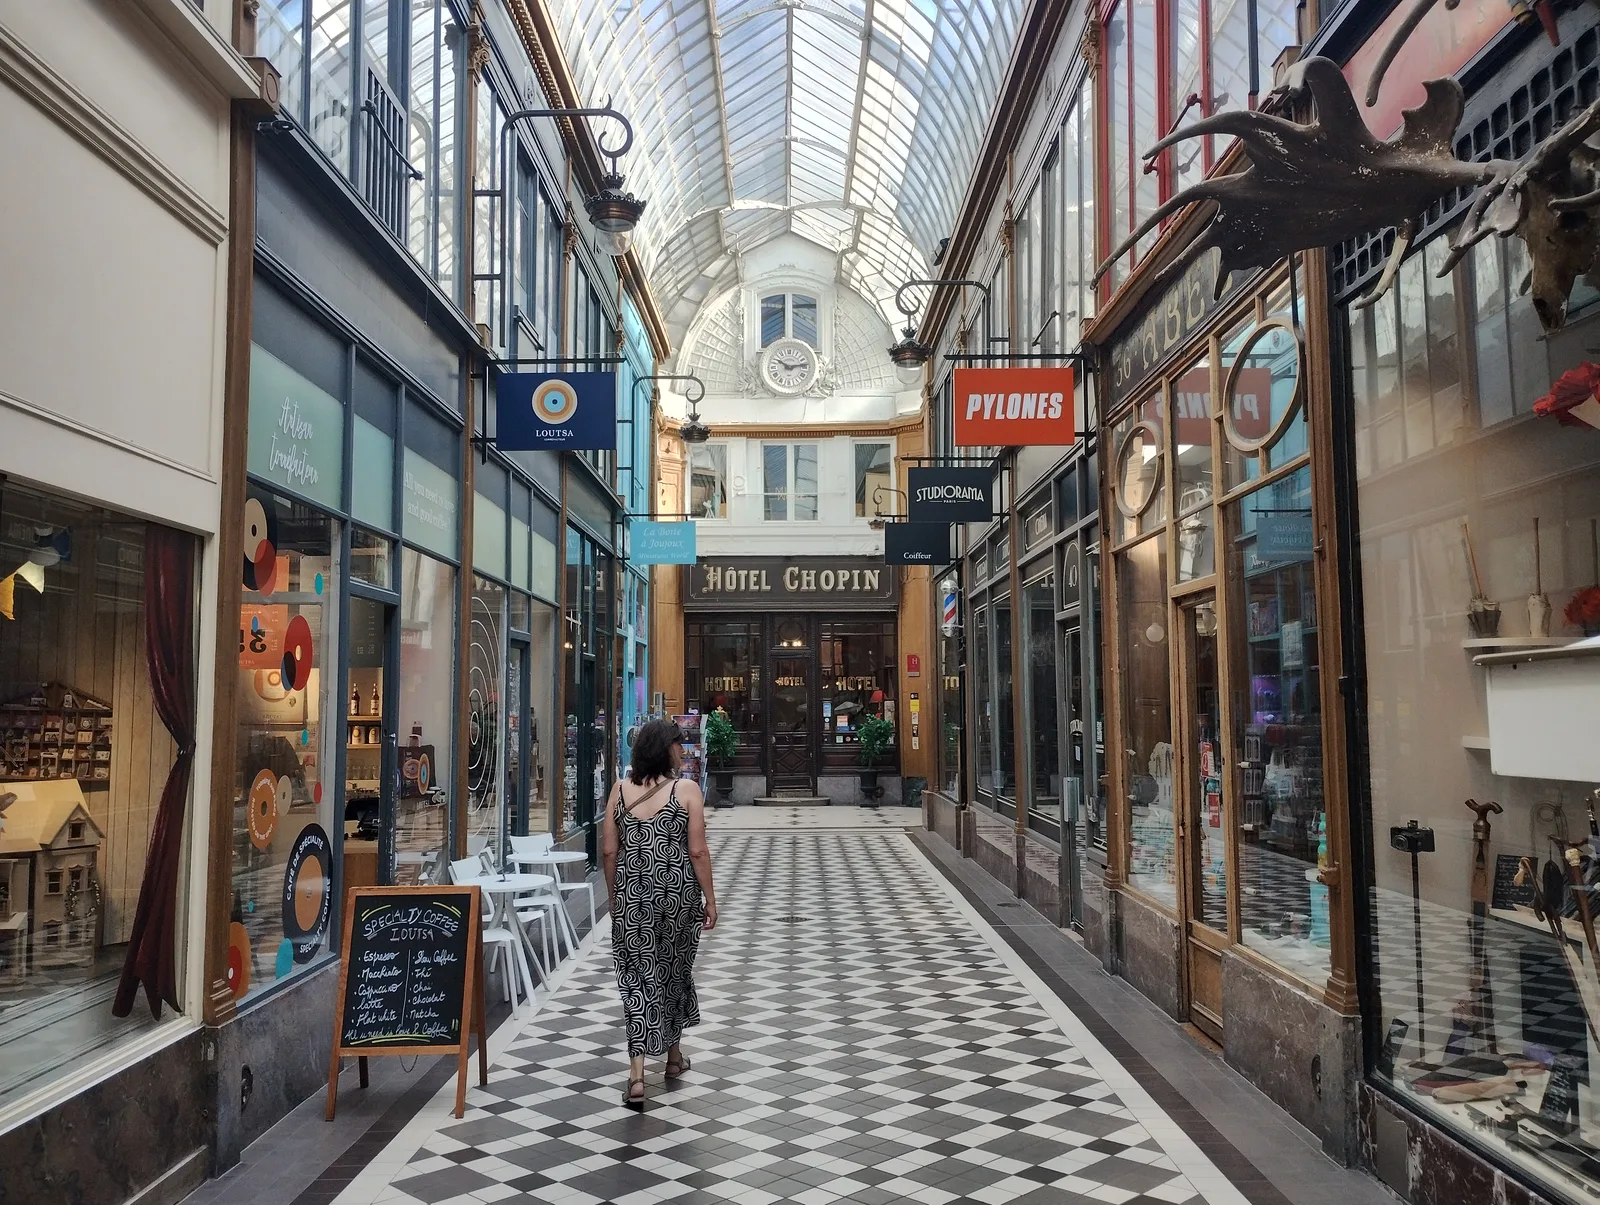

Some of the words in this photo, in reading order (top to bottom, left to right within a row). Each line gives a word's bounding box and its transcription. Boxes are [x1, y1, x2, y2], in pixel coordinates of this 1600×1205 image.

[965, 392, 1064, 420] PYLONES
[535, 429, 574, 437] LOUTSA
[916, 485, 985, 502] STUDIORAMA
[643, 527, 655, 536] La
[648, 539, 684, 551] Joujoux
[903, 551, 932, 560] Coiffeur
[703, 564, 771, 593] HÔTEL
[782, 566, 881, 592] CHOPIN
[704, 676, 747, 692] HOTEL
[778, 676, 805, 687] HOTEL
[837, 676, 880, 691] HOTEL
[292, 851, 300, 867] DE
[299, 925, 323, 954] SPECIALTY
[322, 878, 331, 922] COFFEE
[363, 907, 422, 937] SPECIALTY
[422, 909, 459, 932] COFFEE
[363, 950, 400, 967] Espresso
[433, 949, 458, 967] Coffee
[421, 1022, 449, 1038] Coffee
